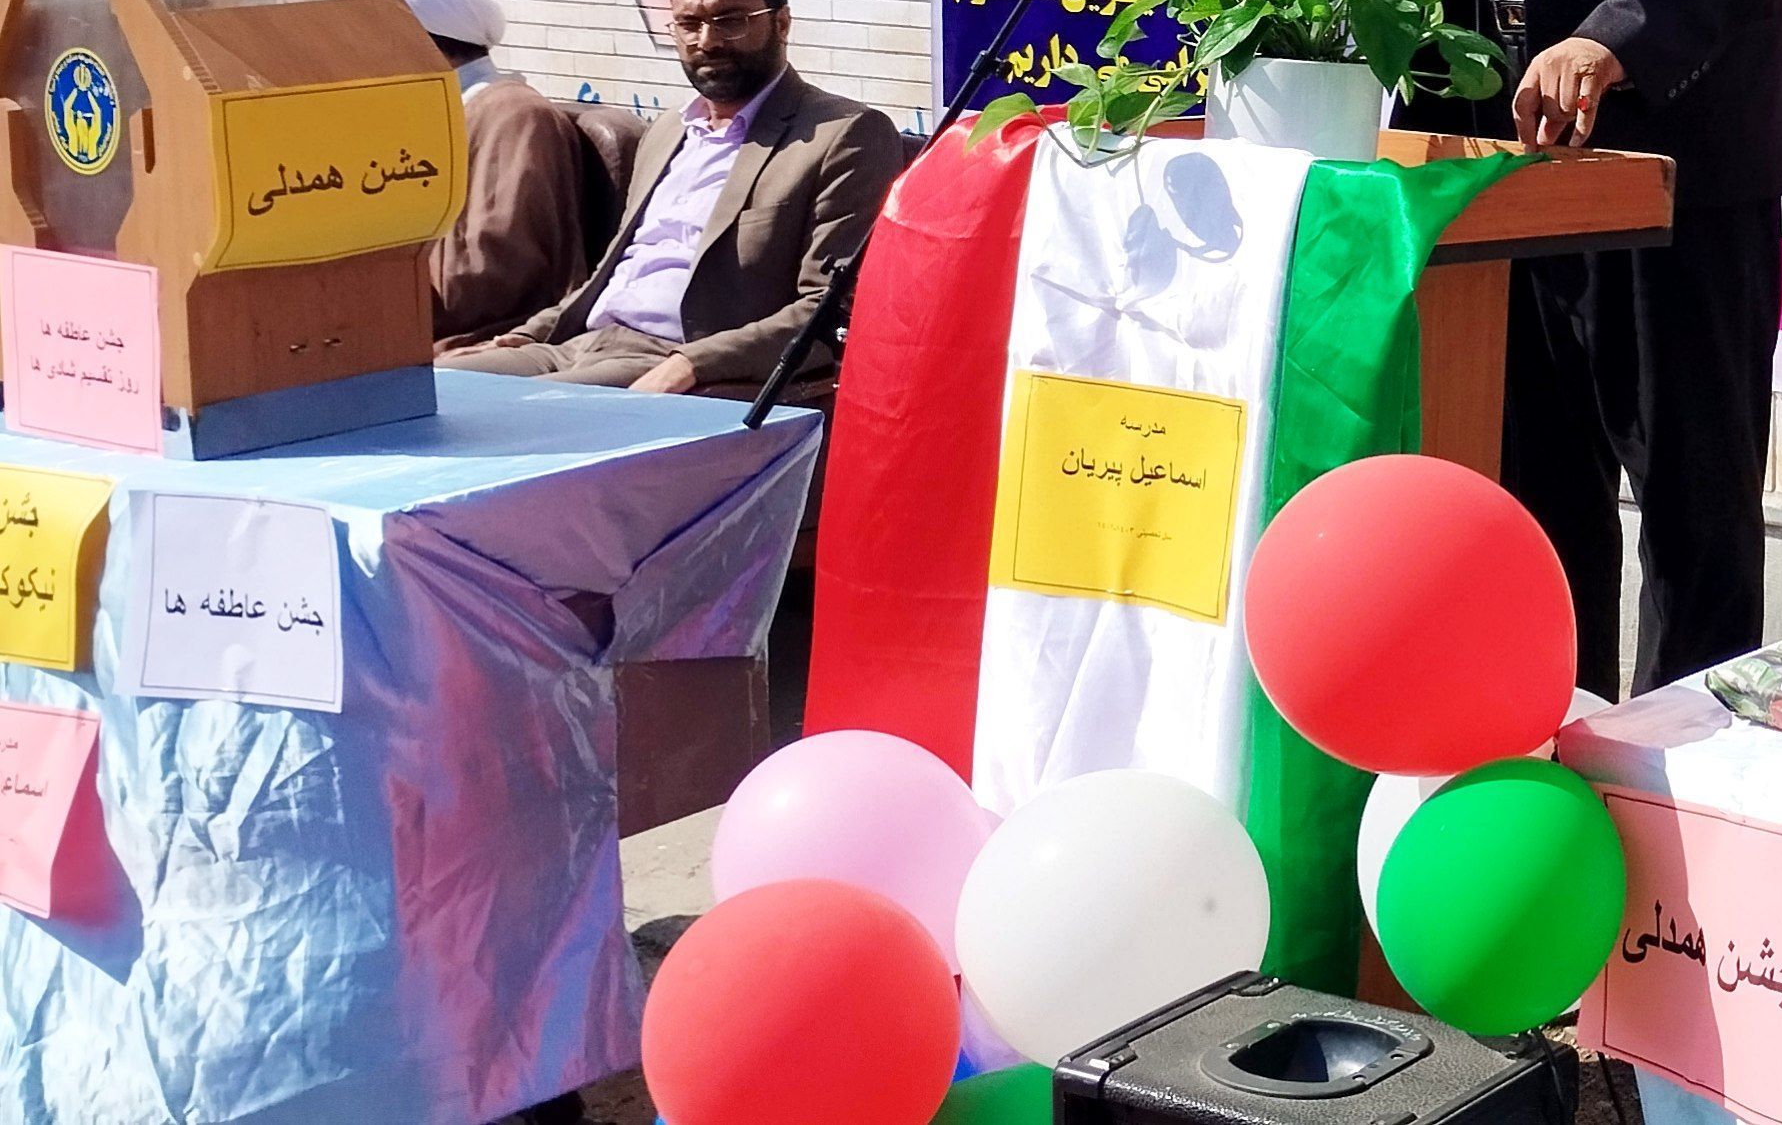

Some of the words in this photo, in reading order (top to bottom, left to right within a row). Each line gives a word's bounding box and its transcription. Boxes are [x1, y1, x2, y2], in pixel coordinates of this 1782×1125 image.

[1008, 33, 1078, 87] داریم
[247, 163, 344, 216] همدلی
[361, 148, 438, 195] جشن
[57, 321, 90, 341] عاطفه
[97, 329, 124, 354] جشن
[80, 365, 113, 387] تقسیم
[1120, 415, 1166, 437] مدرسه
[1062, 448, 1122, 487] پیریان
[1130, 455, 1207, 491] اسماعیل
[164, 588, 187, 617] ها
[200, 590, 267, 620] عاطفه
[277, 597, 325, 637] جشن
[1622, 901, 1709, 966] همدلی
